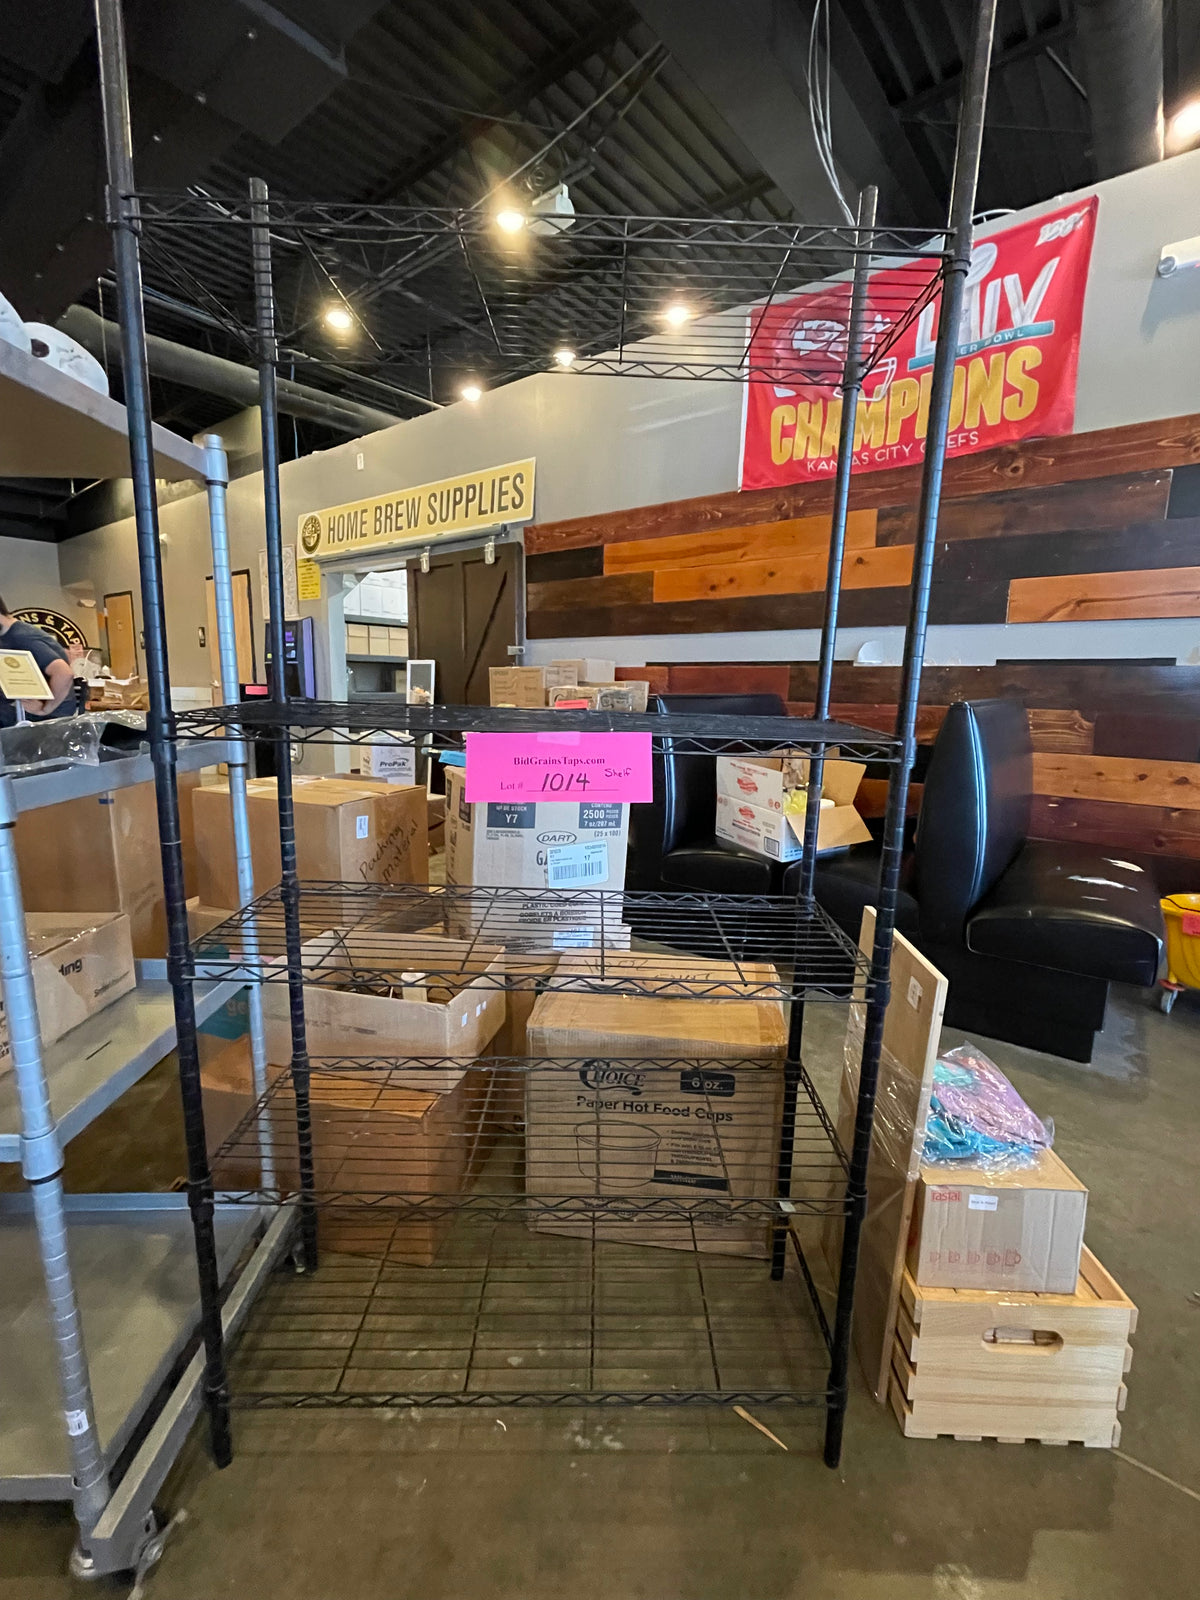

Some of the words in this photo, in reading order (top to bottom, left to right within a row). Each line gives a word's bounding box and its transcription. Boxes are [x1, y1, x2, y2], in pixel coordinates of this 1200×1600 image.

[874, 442, 913, 462] CITY
[327, 507, 369, 545] HOME
[373, 494, 422, 536] BREW
[426, 471, 525, 526] SUPPLIES
[379, 760, 407, 768] ProPak
[513, 756, 606, 767] BidGrainsTaps.com
[603, 767, 632, 778] Shelf
[500, 781, 516, 791] Lot
[517, 781, 524, 790] #
[541, 772, 591, 792] 1014
[505, 813, 519, 824] Y7
[583, 809, 604, 819] 2500
[541, 834, 573, 843] DART
[691, 1077, 700, 1088] 6
[704, 1079, 724, 1091] oz.
[576, 1095, 622, 1111] Paper
[622, 1101, 650, 1114] Hot
[653, 1103, 691, 1118] Food
[694, 1107, 734, 1123] Cups
